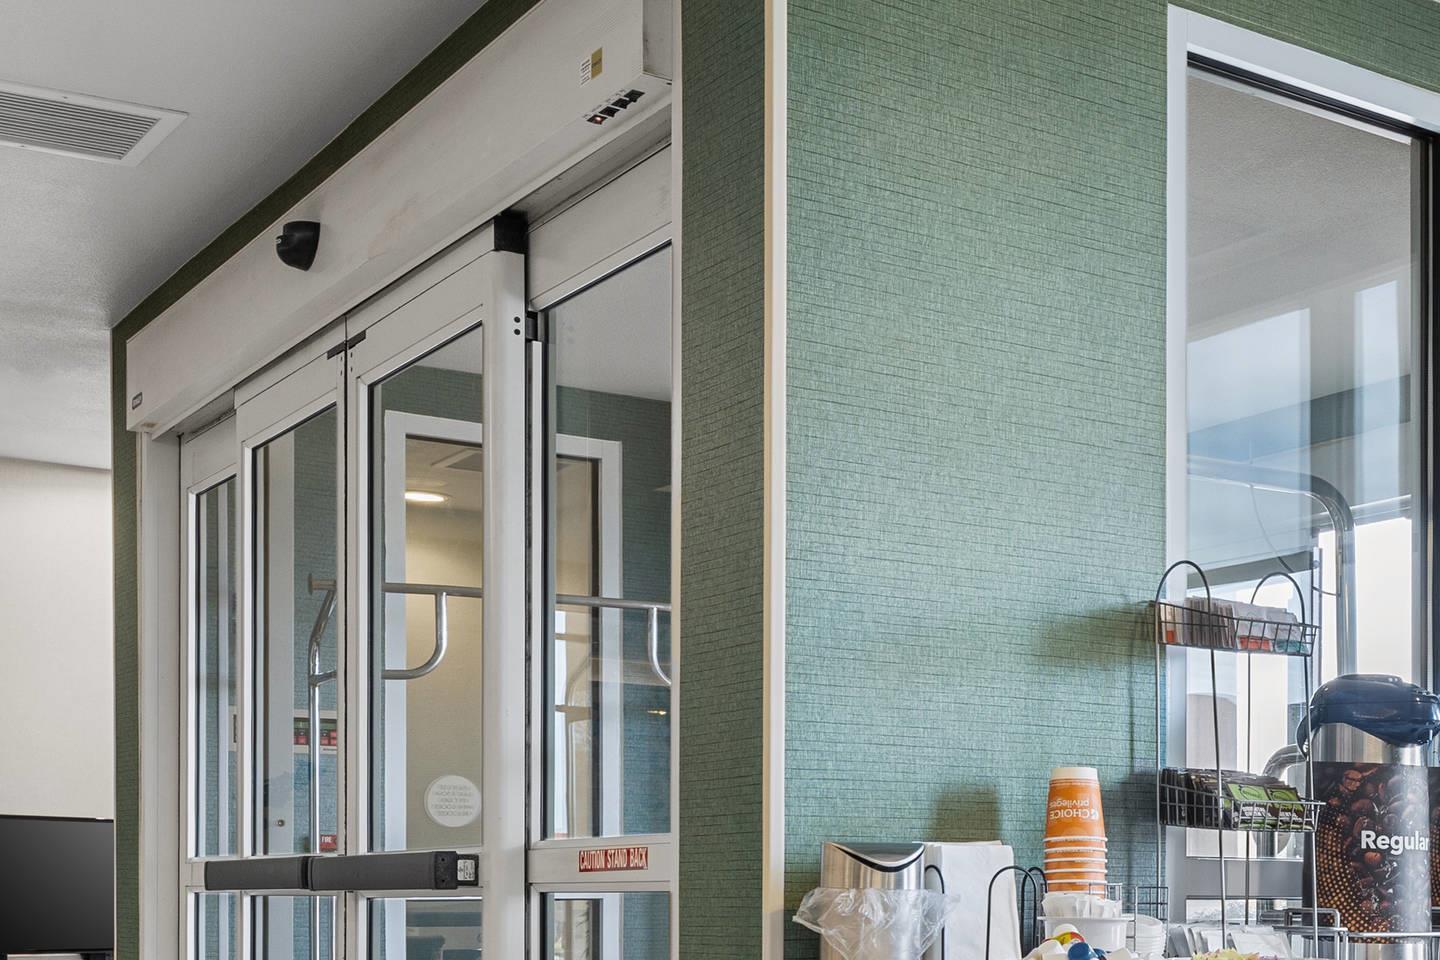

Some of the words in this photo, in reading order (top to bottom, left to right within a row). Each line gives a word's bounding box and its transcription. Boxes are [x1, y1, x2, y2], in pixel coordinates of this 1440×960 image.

[1049, 808, 1090, 820] CHOICE
[1361, 830, 1429, 855] Regular
[580, 850, 605, 870] CAUTION
[607, 848, 627, 869] STAND
[629, 847, 647, 868] BACK
